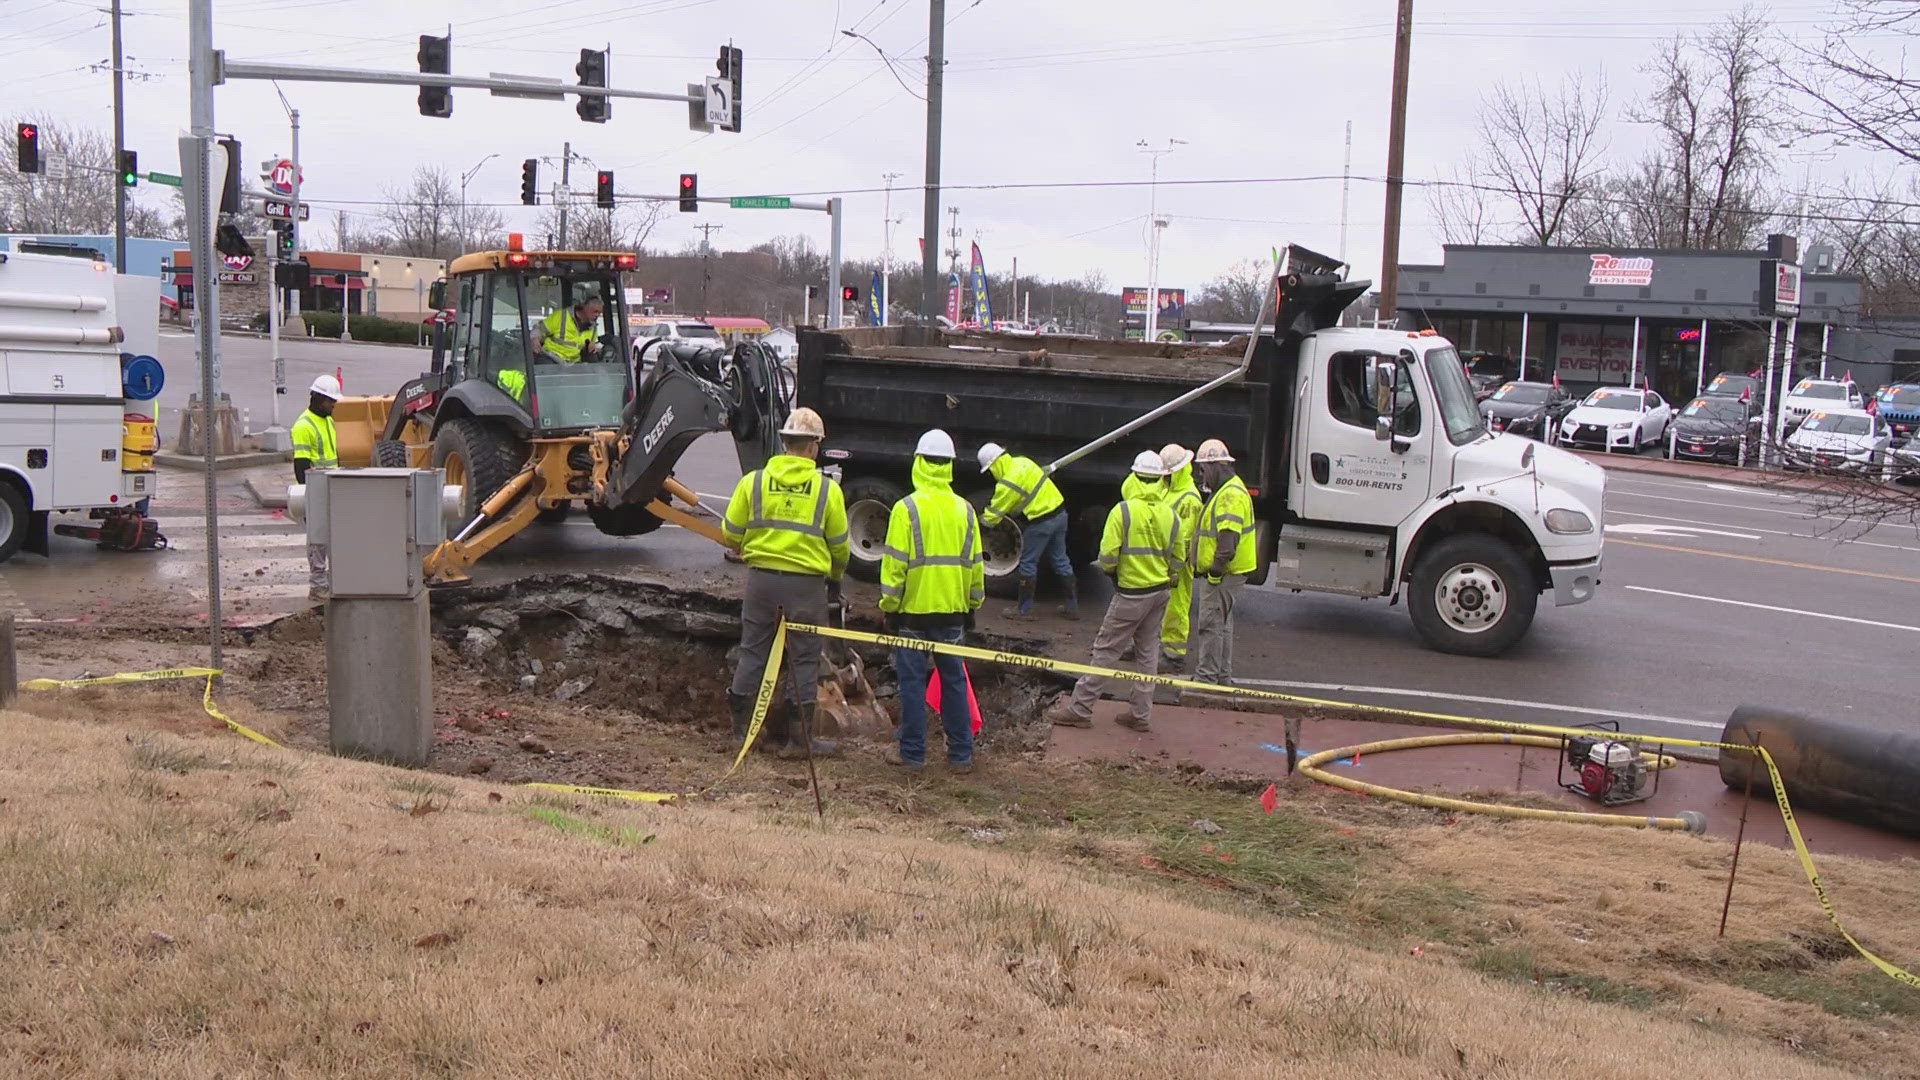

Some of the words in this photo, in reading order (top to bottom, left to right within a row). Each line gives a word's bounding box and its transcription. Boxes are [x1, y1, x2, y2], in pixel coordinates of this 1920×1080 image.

[709, 110, 729, 122] ONLY
[266, 202, 285, 217] Grill
[741, 199, 766, 207] CHARLES
[767, 199, 781, 207] ROCK
[1591, 254, 1652, 270] Reauto
[219, 272, 234, 282] Grill
[1680, 329, 1700, 340] OPEN
[1561, 334, 1643, 350] FINANCIN
[406, 383, 426, 399] DEERE
[643, 405, 675, 455] DEERE
[1335, 477, 1403, 490] 800-UR-RENTS
